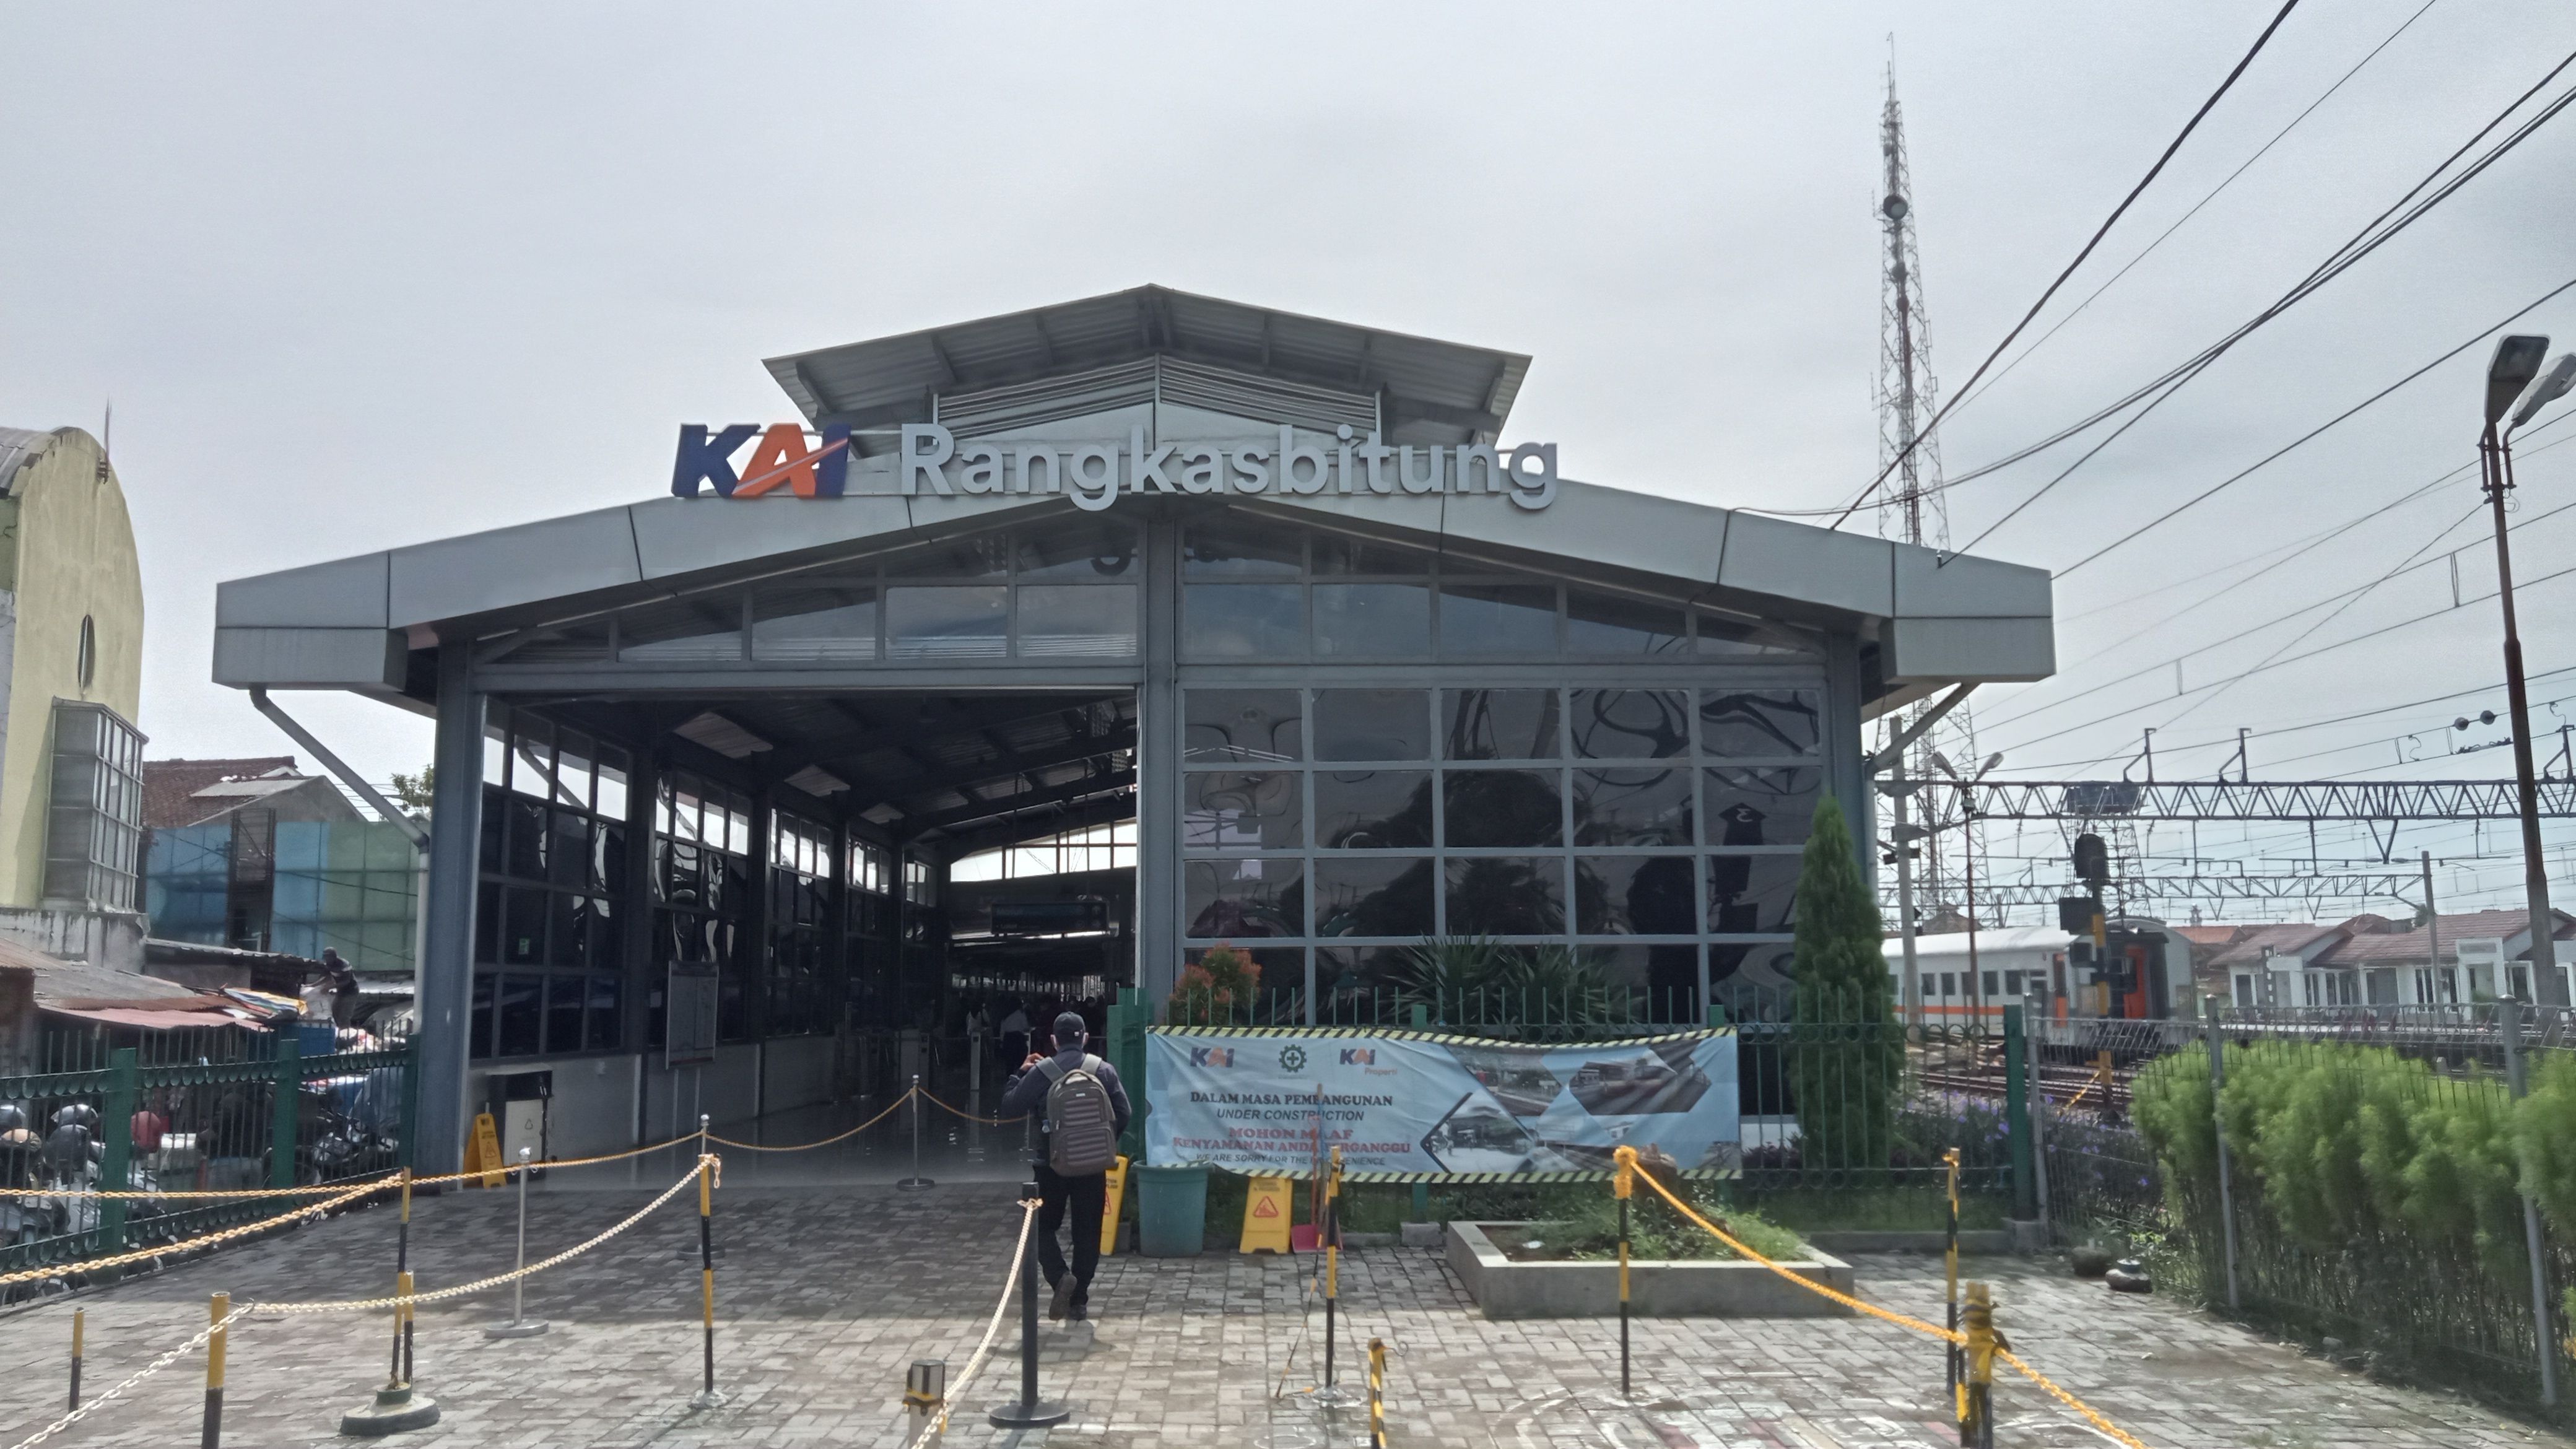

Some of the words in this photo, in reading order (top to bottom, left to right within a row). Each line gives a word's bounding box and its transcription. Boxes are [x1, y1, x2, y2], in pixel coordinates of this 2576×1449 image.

[671, 422, 852, 498] KAI
[901, 422, 1558, 511] Rangkasbitung
[1190, 1046, 1235, 1068] KAI
[1339, 1048, 1376, 1065] KAI
[1190, 1091, 1239, 1104] DALAM
[1242, 1094, 1282, 1105] MASA
[1217, 1108, 1260, 1120] UNDER
[1229, 1127, 1296, 1139] MOHON
[1172, 1137, 1275, 1151] KENYAMANAN
[1212, 1153, 1232, 1162] ARE
[1234, 1154, 1266, 1162] SORRY
[1291, 1155, 1308, 1165] THE
